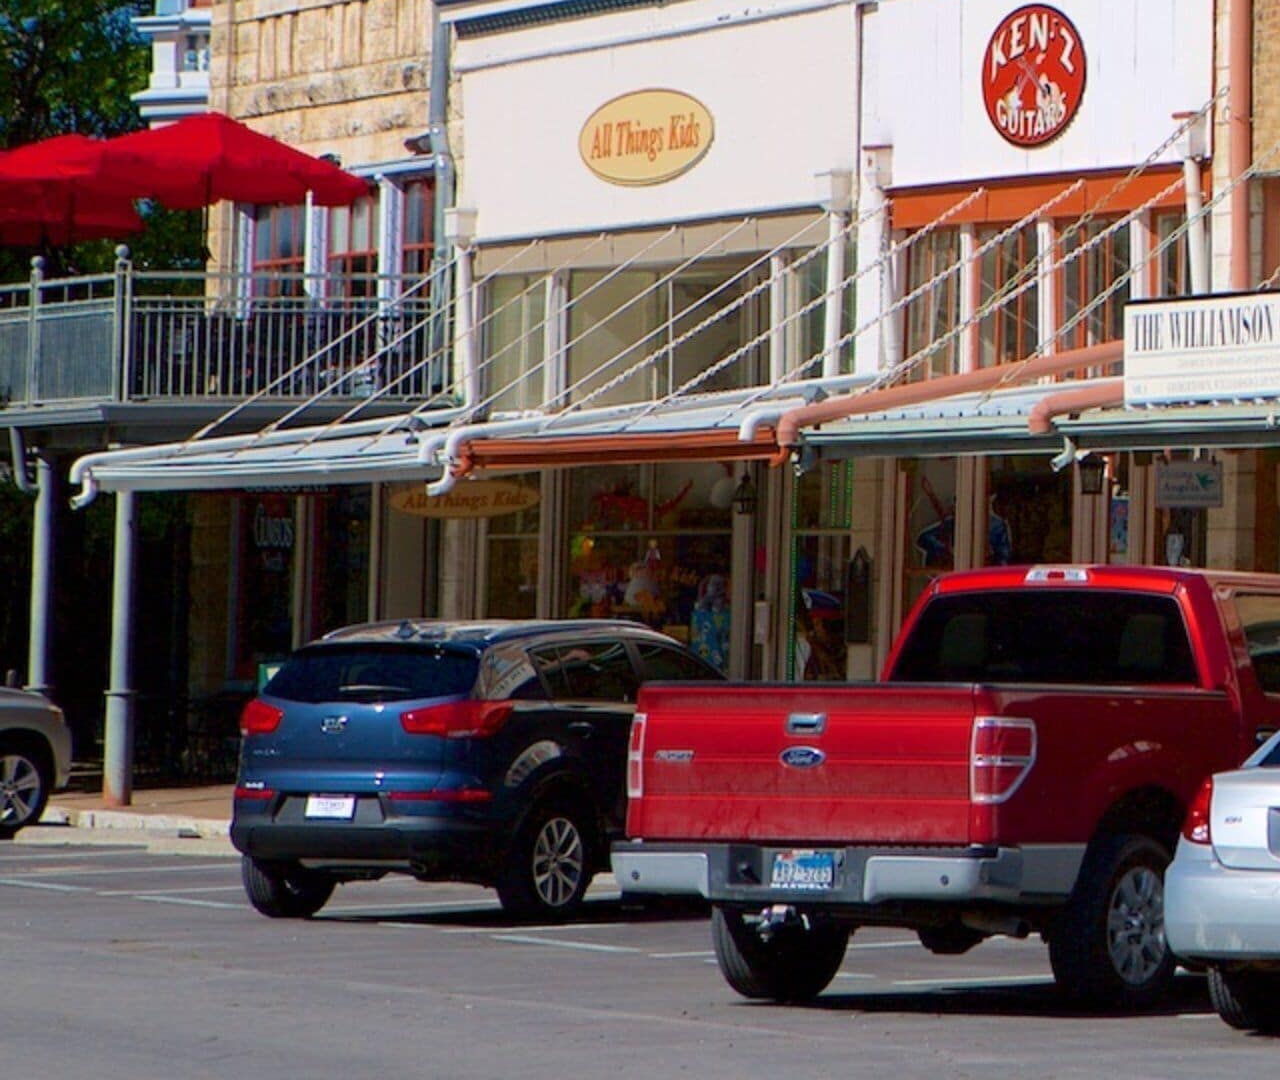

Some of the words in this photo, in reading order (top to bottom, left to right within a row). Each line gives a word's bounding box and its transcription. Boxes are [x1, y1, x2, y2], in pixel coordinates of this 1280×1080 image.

[591, 123, 612, 160] All
[616, 120, 664, 162] Things
[668, 112, 700, 150] Kids
[996, 92, 1067, 137] GUITARS
[1131, 313, 1164, 352] THE
[1168, 304, 1277, 349] WILLIAMSON
[403, 488, 427, 509] All
[432, 488, 487, 510] Things
[493, 486, 529, 507] Kids
[786, 751, 814, 765] Ford
